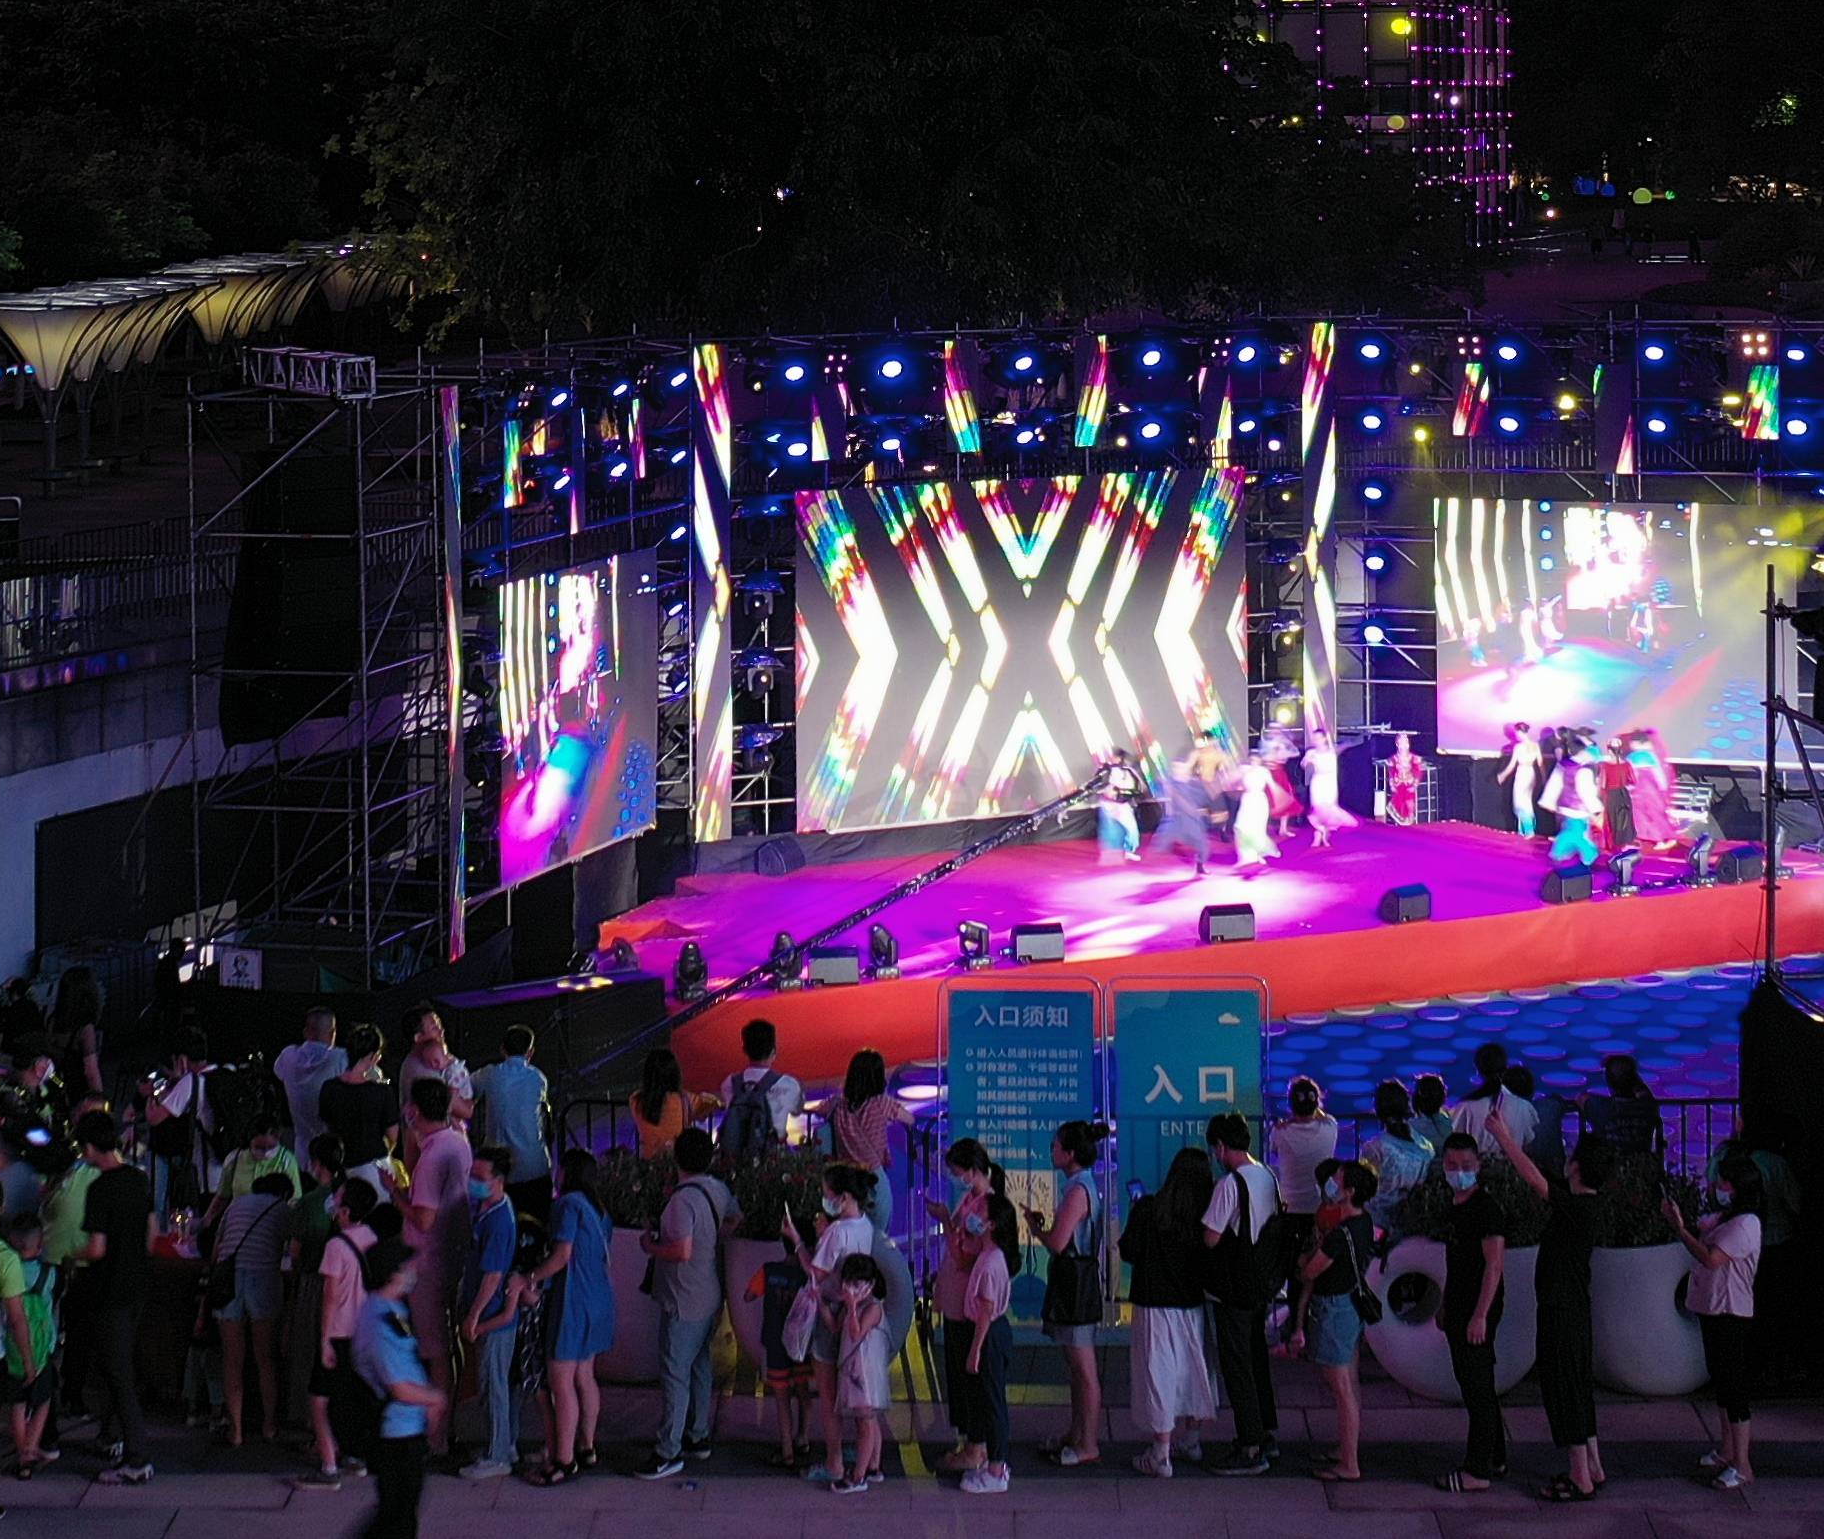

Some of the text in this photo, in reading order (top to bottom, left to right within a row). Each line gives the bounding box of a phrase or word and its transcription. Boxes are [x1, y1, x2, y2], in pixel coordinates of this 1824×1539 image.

[974, 1004, 1069, 1027] 入口须知
[1144, 1064, 1235, 1104] 入口
[1161, 1120, 1206, 1136] ENTE
